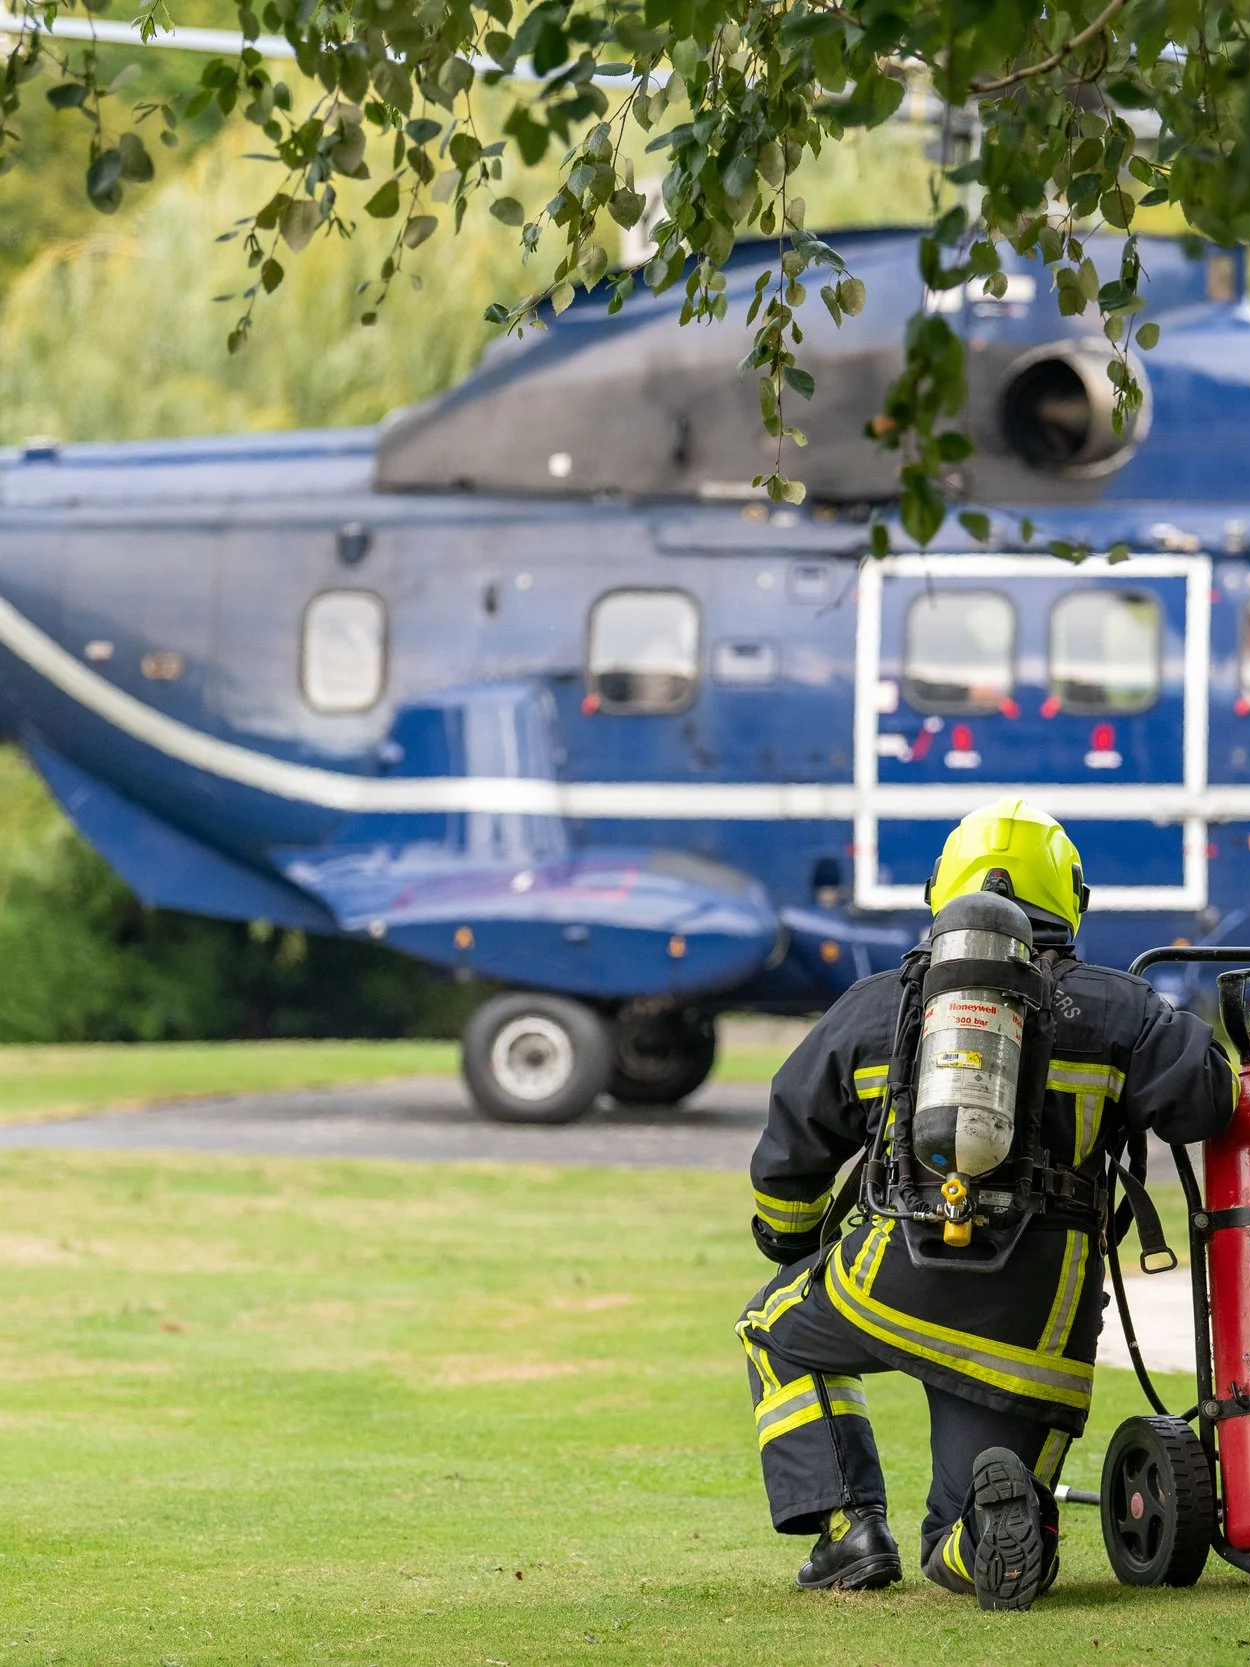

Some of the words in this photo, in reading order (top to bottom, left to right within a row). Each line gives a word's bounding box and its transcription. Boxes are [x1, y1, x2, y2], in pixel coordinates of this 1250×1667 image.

[949, 1003, 997, 1014] Honeywell
[955, 1016, 972, 1024] 300
[974, 1017, 989, 1027] bar
